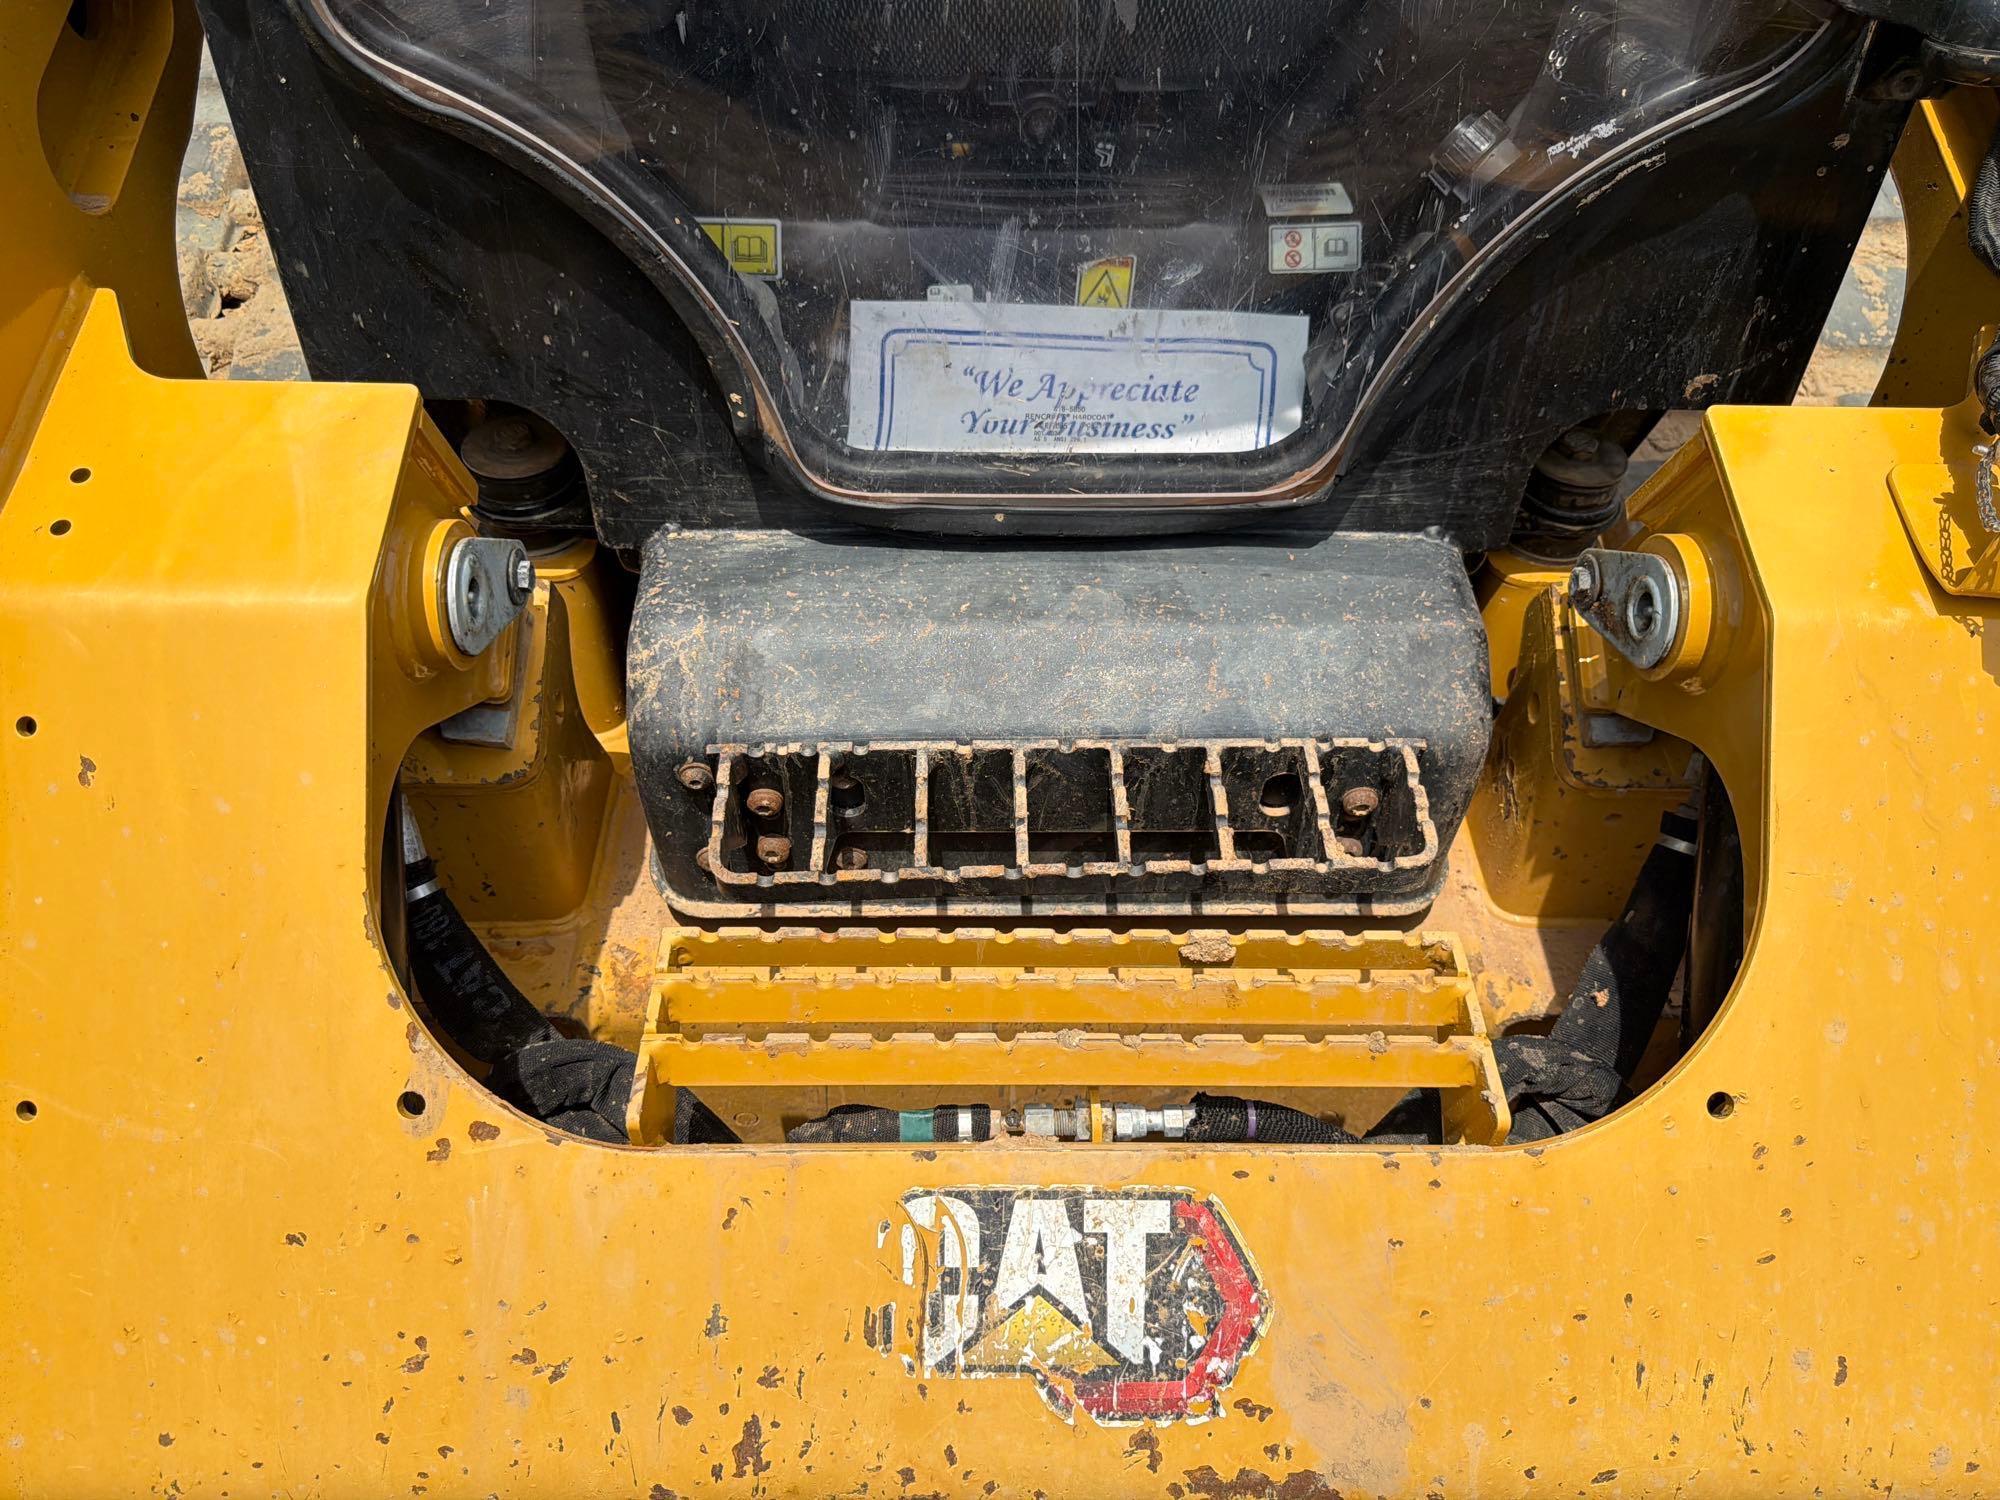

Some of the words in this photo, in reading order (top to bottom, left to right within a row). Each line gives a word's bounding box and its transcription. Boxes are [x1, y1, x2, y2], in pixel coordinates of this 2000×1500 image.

[962, 366, 1024, 398] “We
[1026, 373, 1200, 409] Appreciate
[960, 408, 1036, 436] Your
[900, 1195, 1171, 1367] CAT
